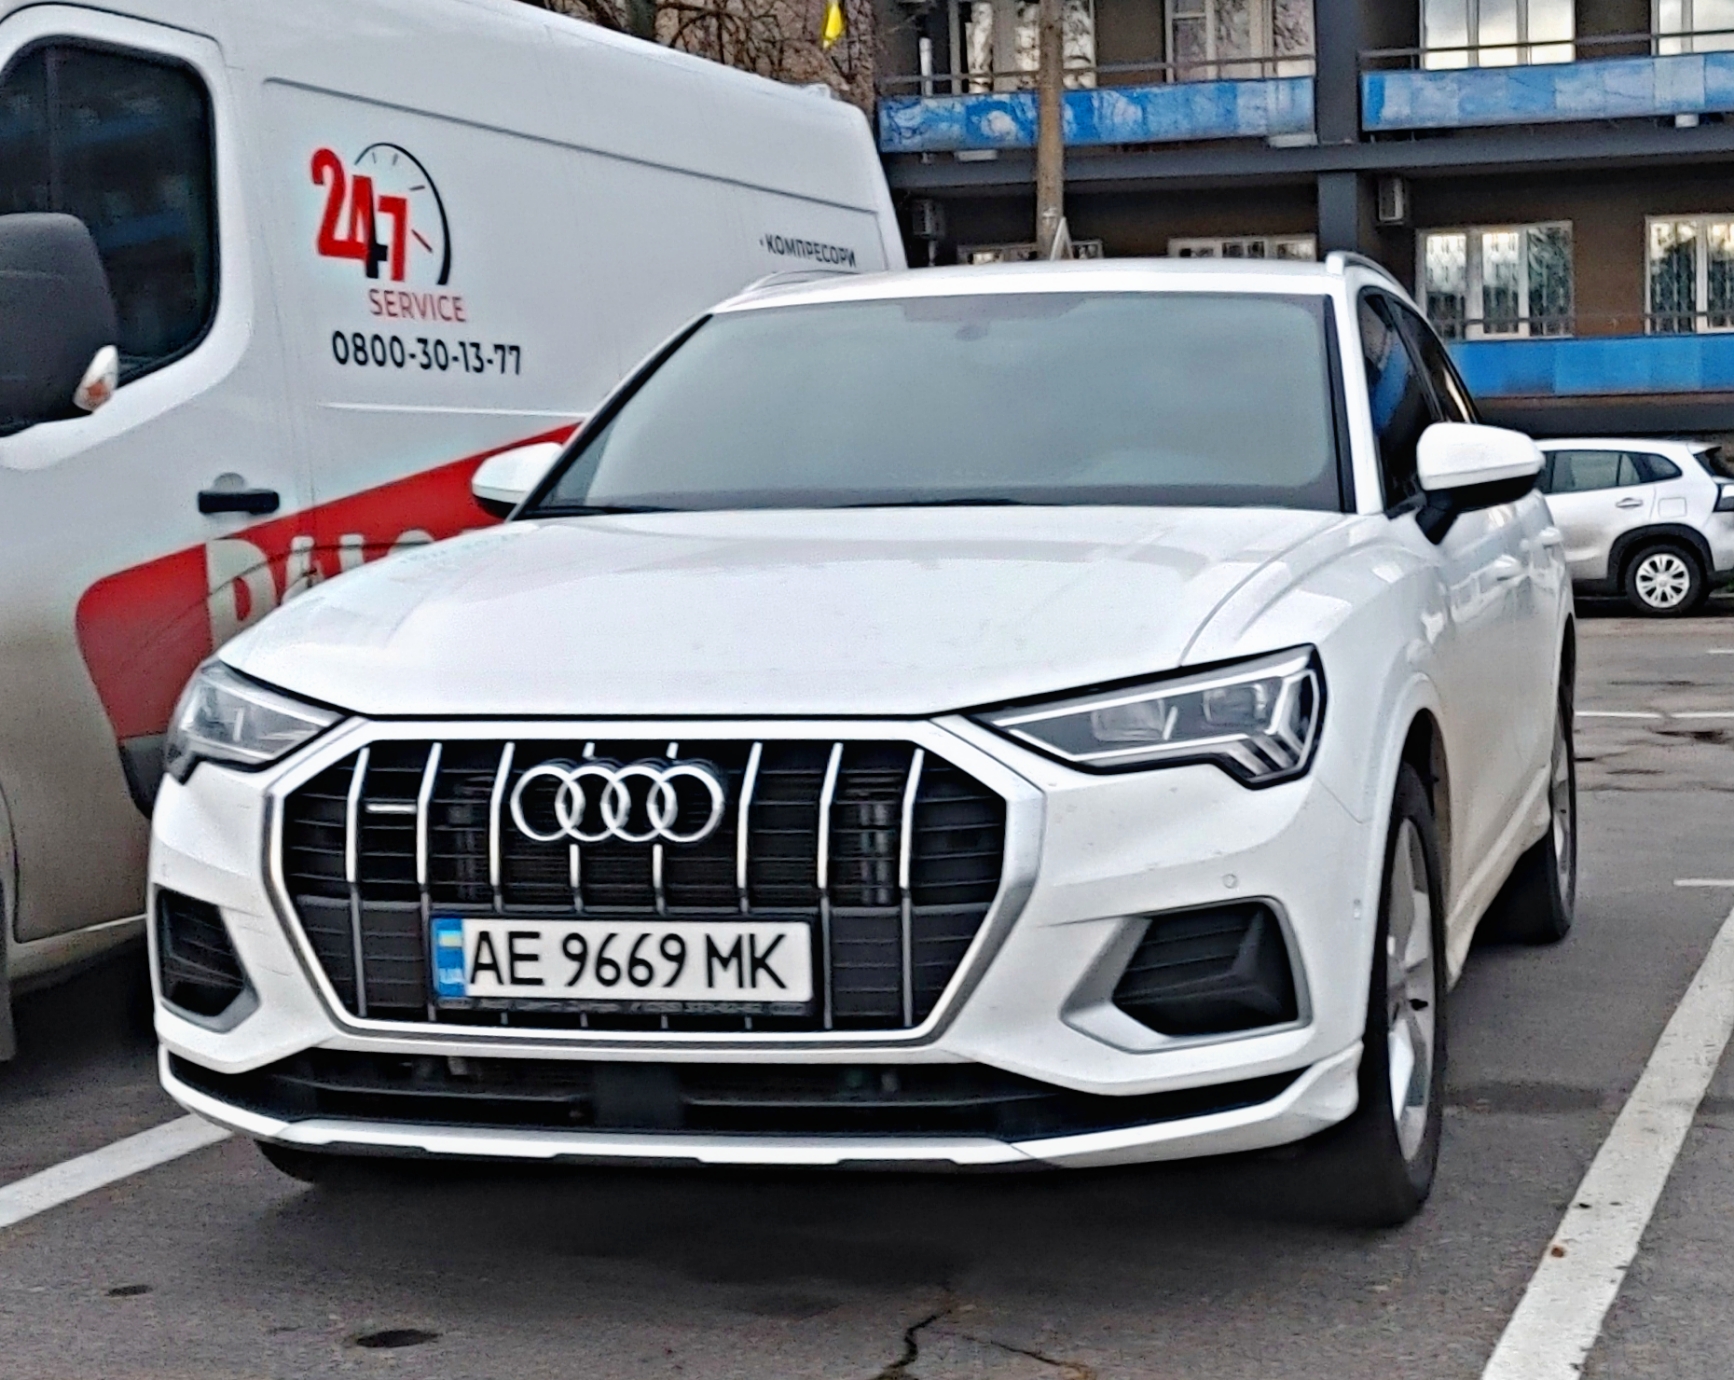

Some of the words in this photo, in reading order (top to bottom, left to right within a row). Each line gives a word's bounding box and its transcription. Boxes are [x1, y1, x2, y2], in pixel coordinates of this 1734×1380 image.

[368, 288, 467, 323] SERVICE
[332, 330, 521, 375] 0800-30-13-77
[470, 930, 545, 986] AE
[562, 932, 686, 987] 9669
[705, 933, 787, 989] MK
